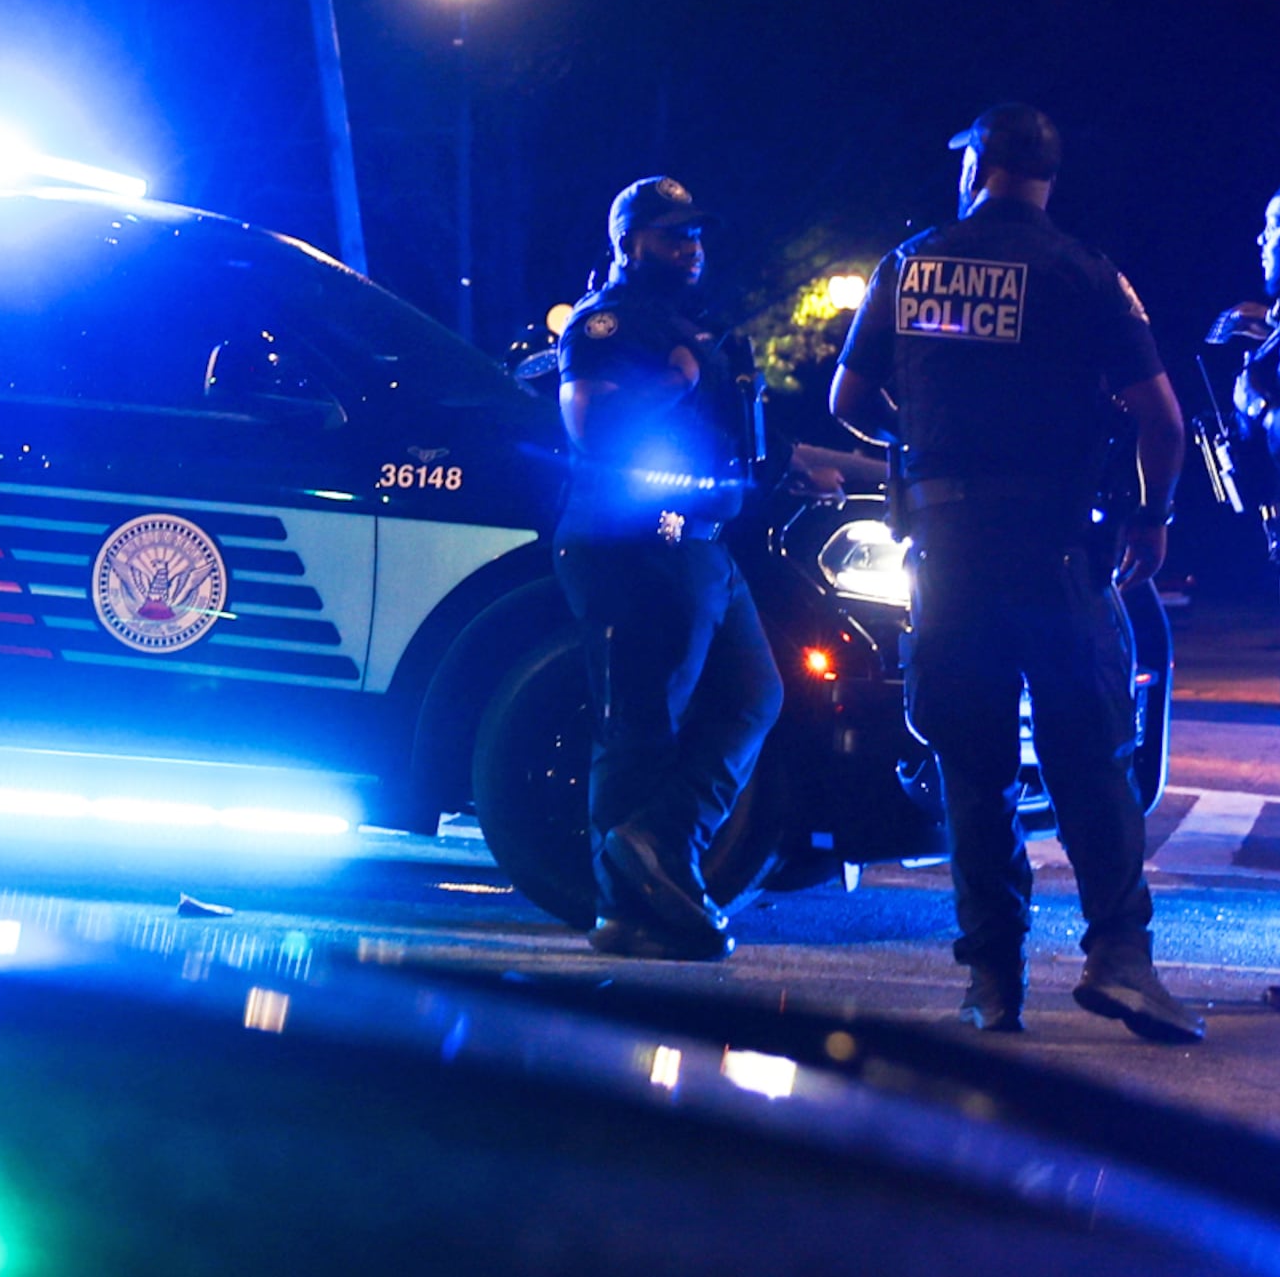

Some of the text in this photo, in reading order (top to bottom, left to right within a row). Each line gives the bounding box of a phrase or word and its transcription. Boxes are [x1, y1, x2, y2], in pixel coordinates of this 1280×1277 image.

[901, 261, 1018, 301] ATLANTA
[900, 296, 1018, 338] POLICE
[379, 463, 463, 491] 36148
